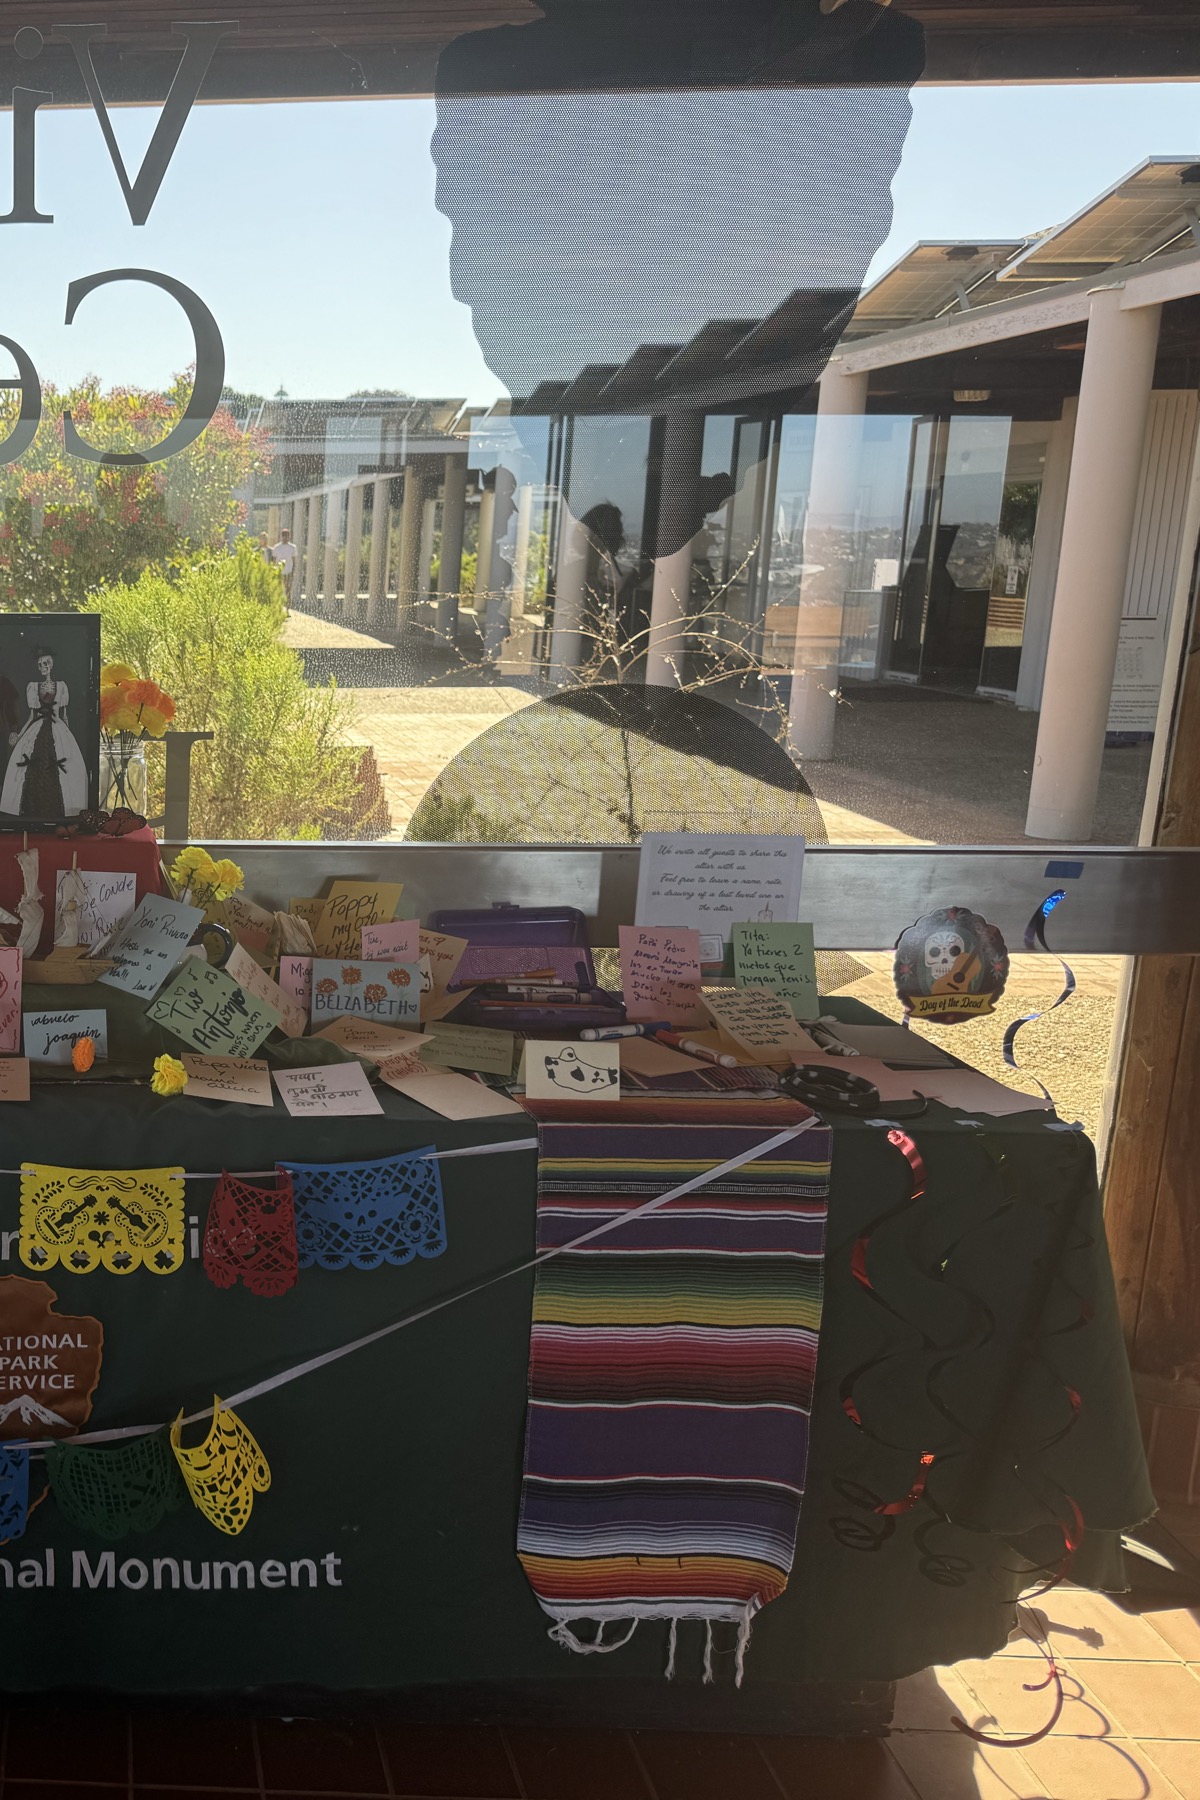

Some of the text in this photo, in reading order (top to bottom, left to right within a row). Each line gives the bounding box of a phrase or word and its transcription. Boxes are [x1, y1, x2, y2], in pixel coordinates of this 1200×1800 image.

[697, 848, 709, 856] all
[709, 848, 736, 859] guests
[749, 849, 771, 857] share
[717, 863, 734, 871] with
[659, 873, 677, 884] Feel
[679, 876, 695, 885] free
[697, 876, 707, 884] to
[709, 876, 729, 884] leave
[697, 889, 707, 900] of
[718, 890, 733, 898] lost
[734, 891, 756, 899] loved
[327, 892, 378, 920] Poppy
[664, 940, 685, 952] Pedro
[742, 944, 803, 957] Ya tienes 2
[739, 961, 795, 973] nietos que
[315, 993, 408, 1015] BELZABETH
[920, 997, 983, 1011] Day of the Dead
[229, 1011, 262, 1056] miss when
[71, 1548, 343, 1590] Monument
